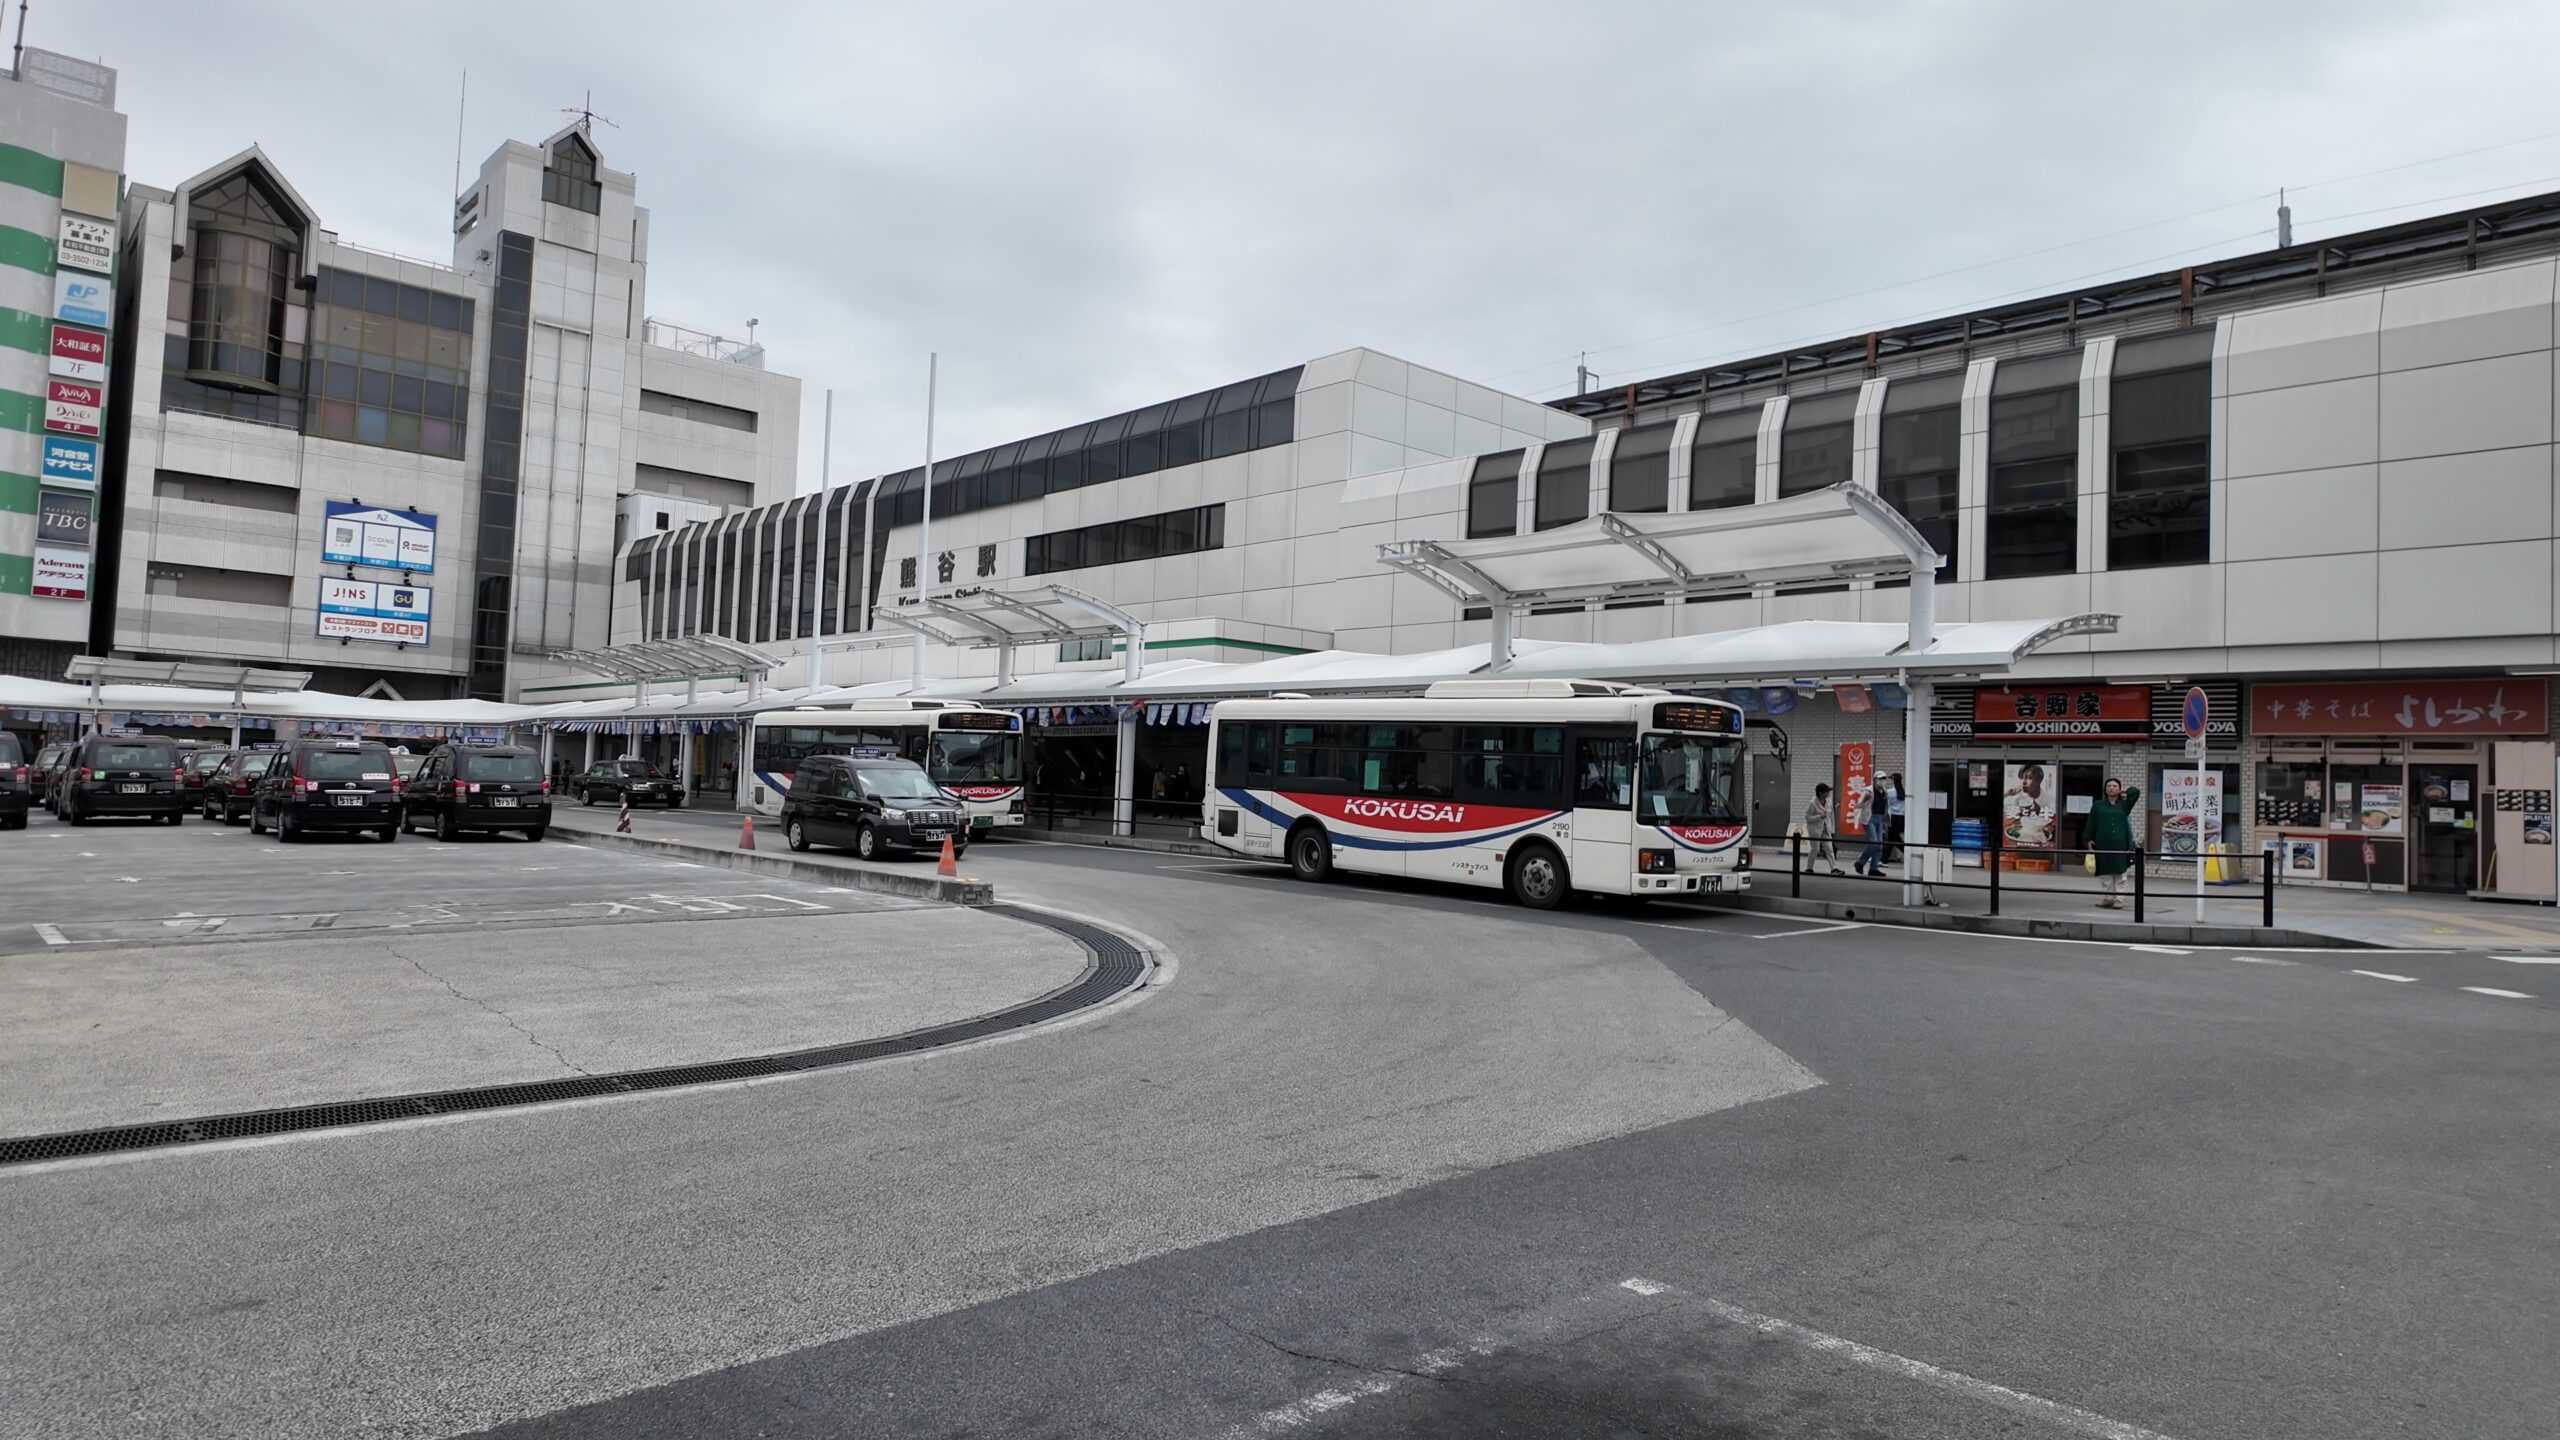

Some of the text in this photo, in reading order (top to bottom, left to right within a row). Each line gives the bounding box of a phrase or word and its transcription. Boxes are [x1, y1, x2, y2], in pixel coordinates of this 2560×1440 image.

[65, 220, 110, 236] テナント
[61, 252, 109, 267] 03-3502-1234
[56, 337, 102, 353] 大和証券
[69, 361, 86, 374] 7F
[45, 458, 93, 472] マナビス
[43, 512, 87, 530] TBC
[38, 558, 85, 569] Aderans
[900, 544, 996, 588] 熊谷駅
[37, 569, 84, 580] アデランス
[50, 588, 68, 596] 2F
[395, 594, 412, 604] GU
[2015, 692, 2101, 718] 吉野家
[2266, 686, 2528, 728] 中華そば よしかわ
[1930, 723, 1972, 733] HINOYA
[2015, 722, 2101, 733] YOSHINOYA
[2153, 721, 2236, 732] YOSOYA
[961, 784, 1005, 794] KOKUSAI
[1344, 798, 1464, 822] KOKUSAI
[1552, 822, 1570, 830] 2190
[1685, 829, 1732, 839] KOKUSAI
